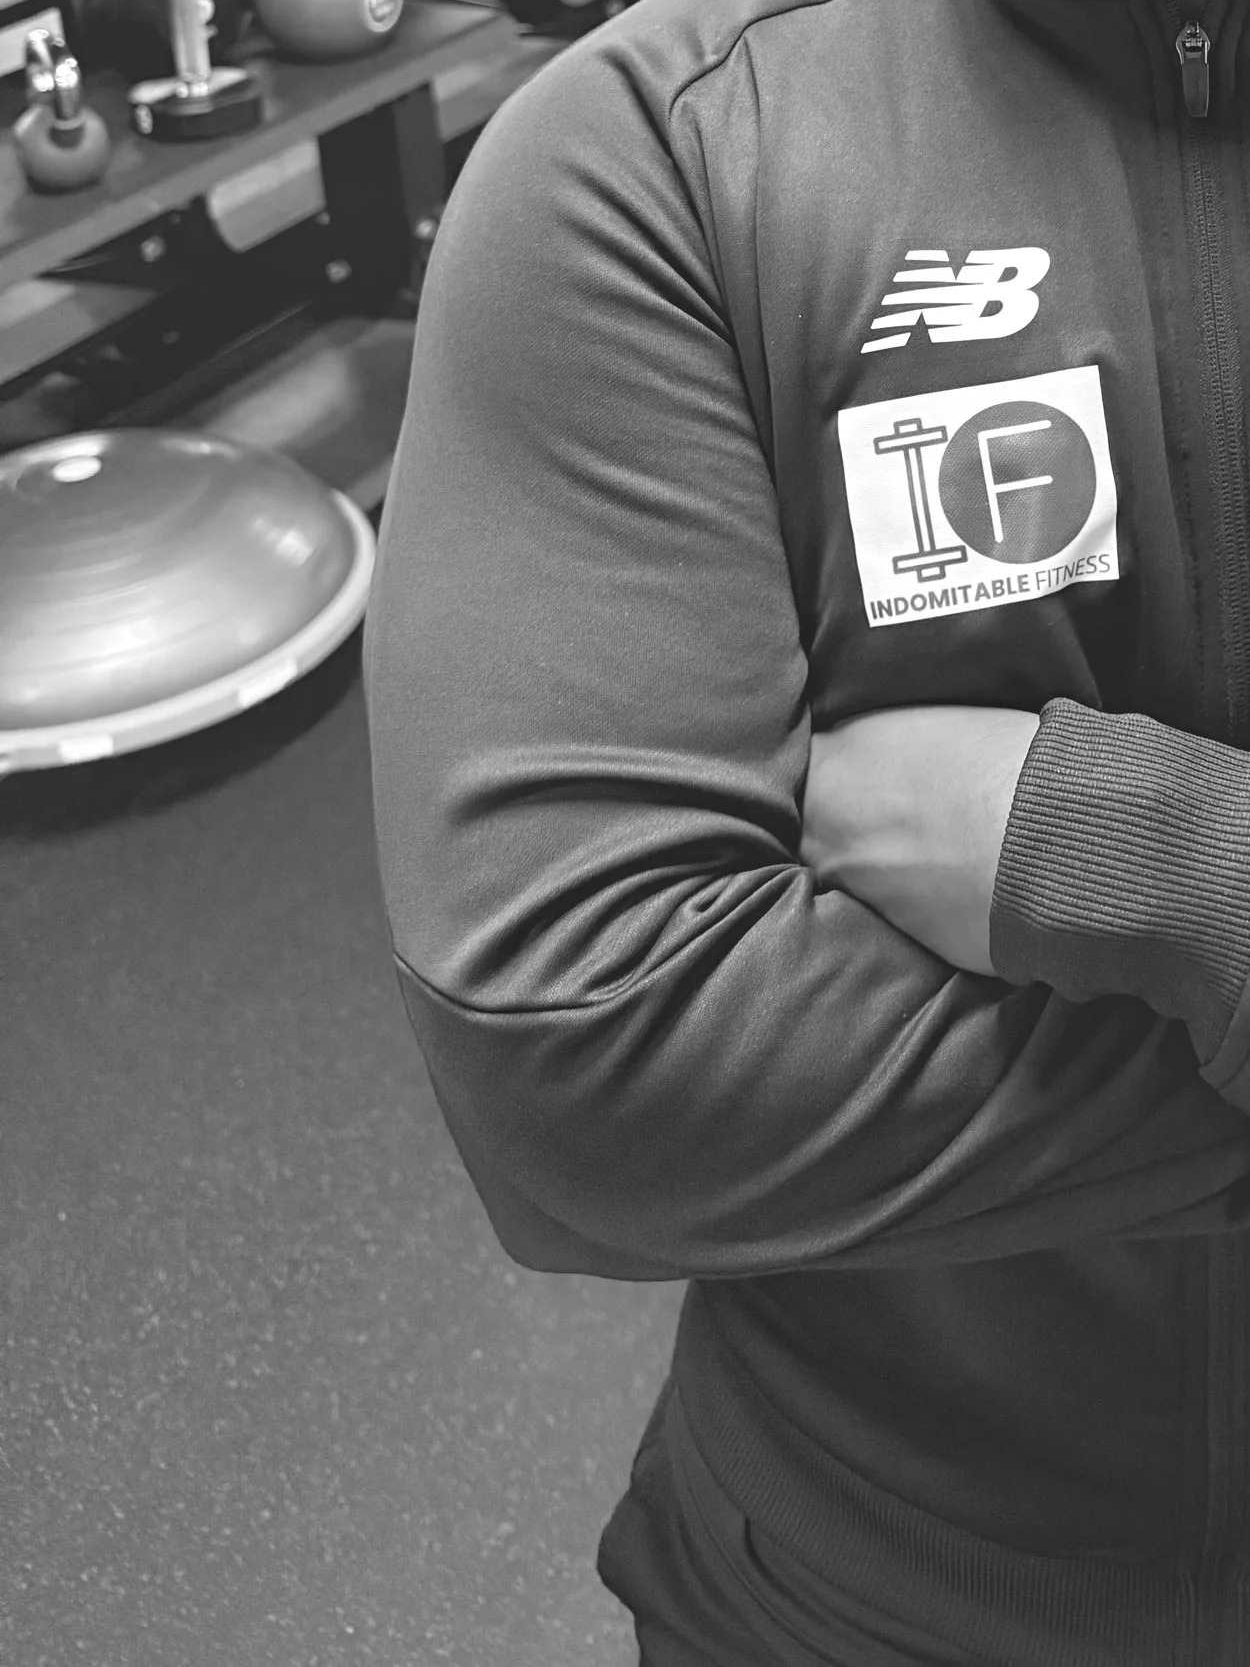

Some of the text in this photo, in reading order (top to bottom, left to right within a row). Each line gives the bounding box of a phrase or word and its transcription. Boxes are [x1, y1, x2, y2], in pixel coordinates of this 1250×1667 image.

[860, 246, 1051, 354] NB
[870, 553, 1112, 620] INDOMITABLE FITNESS
